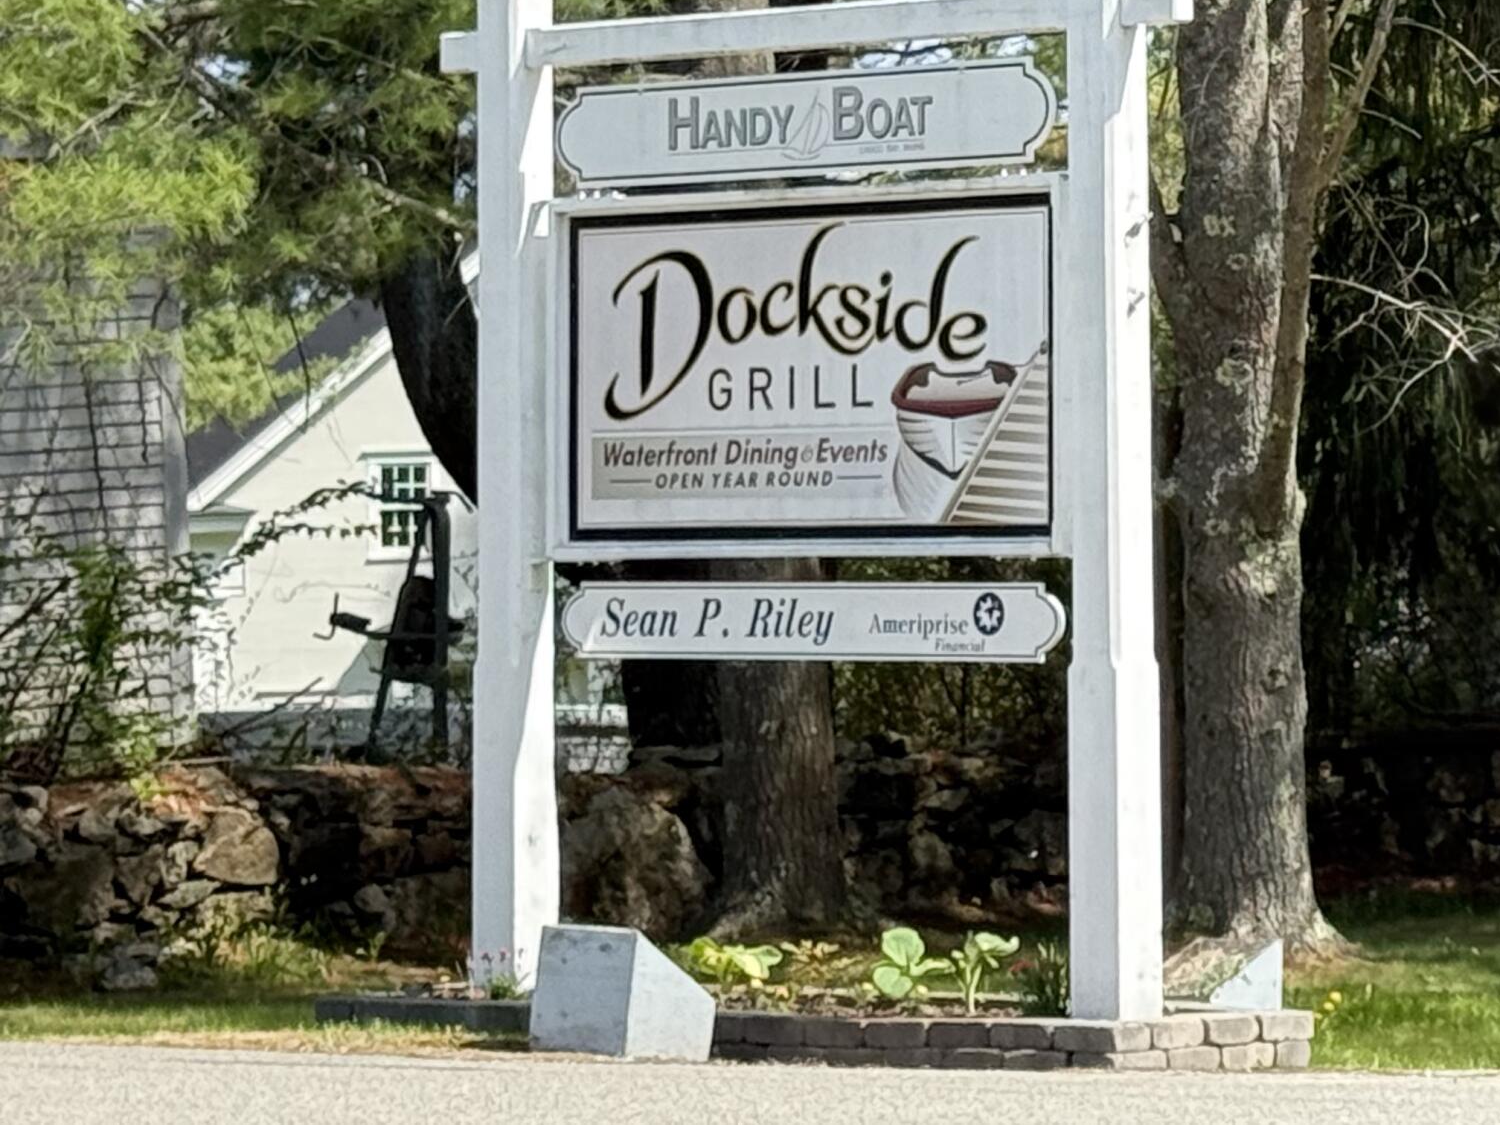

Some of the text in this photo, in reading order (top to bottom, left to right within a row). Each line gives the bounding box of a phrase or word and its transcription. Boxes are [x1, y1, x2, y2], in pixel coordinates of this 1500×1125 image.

[668, 85, 933, 150] HANDY BOAT
[604, 221, 988, 421] Dockside
[708, 364, 874, 411] GRILL
[603, 441, 717, 467] Waterfront
[725, 439, 799, 470] Dining
[816, 437, 888, 464] Events
[655, 470, 833, 489] OPEN YEAR ROUND
[600, 597, 834, 646] Sean P. Riley
[868, 613, 969, 640] Ameriprise
[934, 638, 986, 652] Financial
